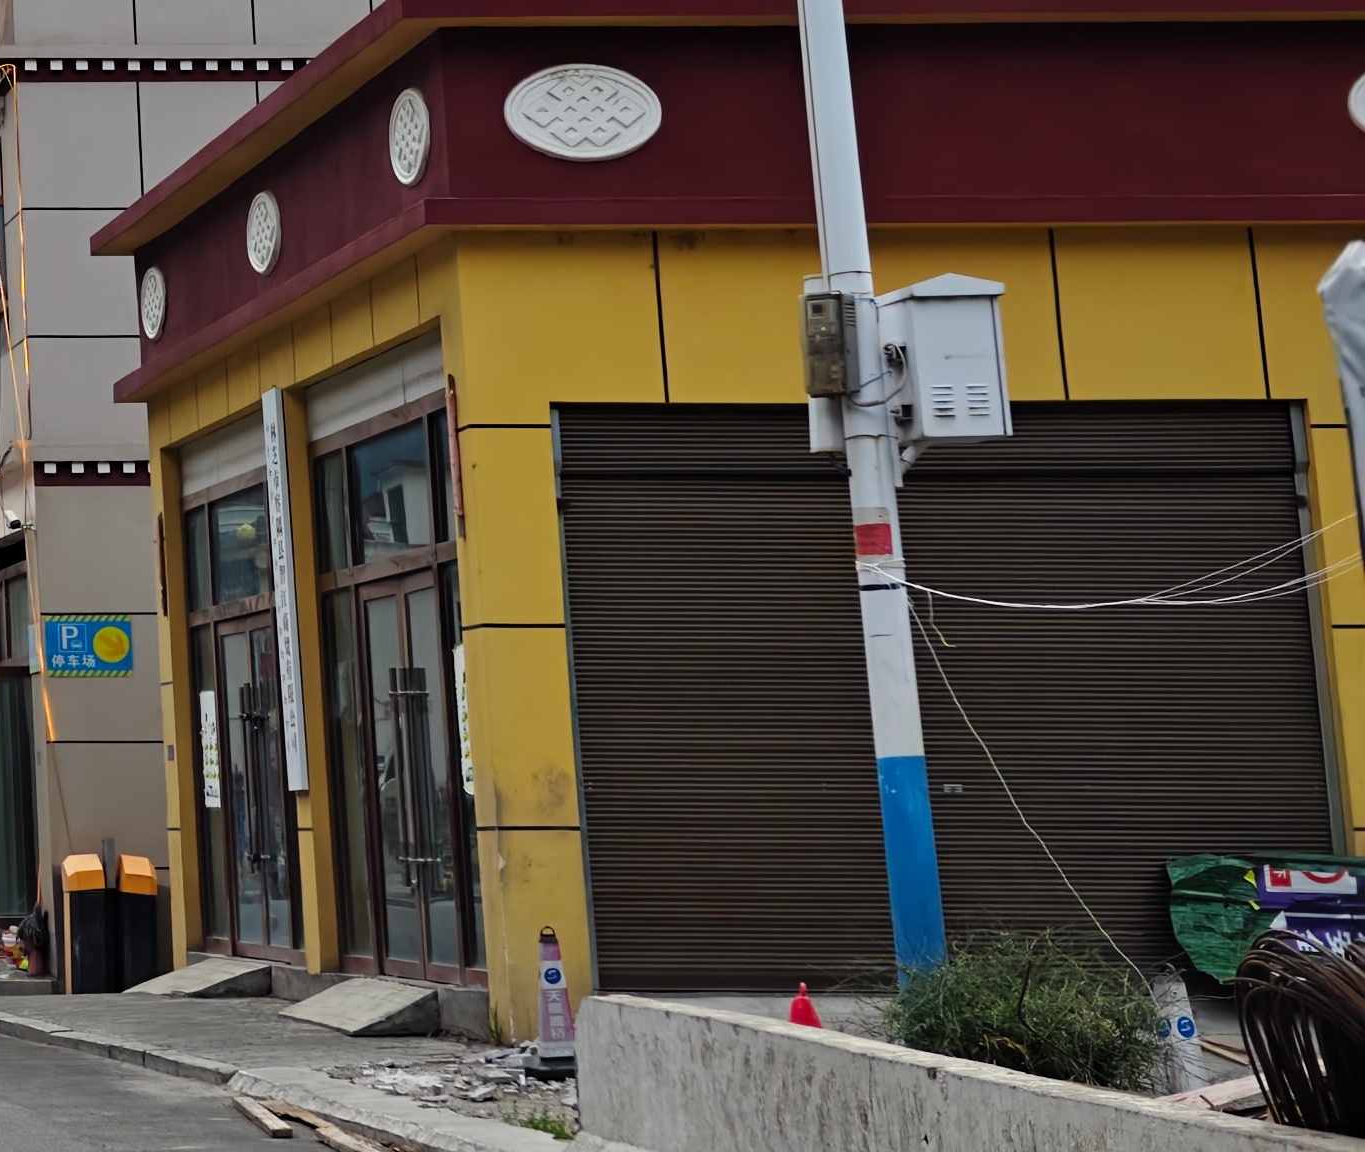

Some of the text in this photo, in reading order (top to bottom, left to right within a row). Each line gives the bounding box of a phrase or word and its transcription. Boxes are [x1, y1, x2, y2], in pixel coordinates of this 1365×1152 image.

[61, 626, 78, 650] P
[51, 654, 96, 668] 停车场
